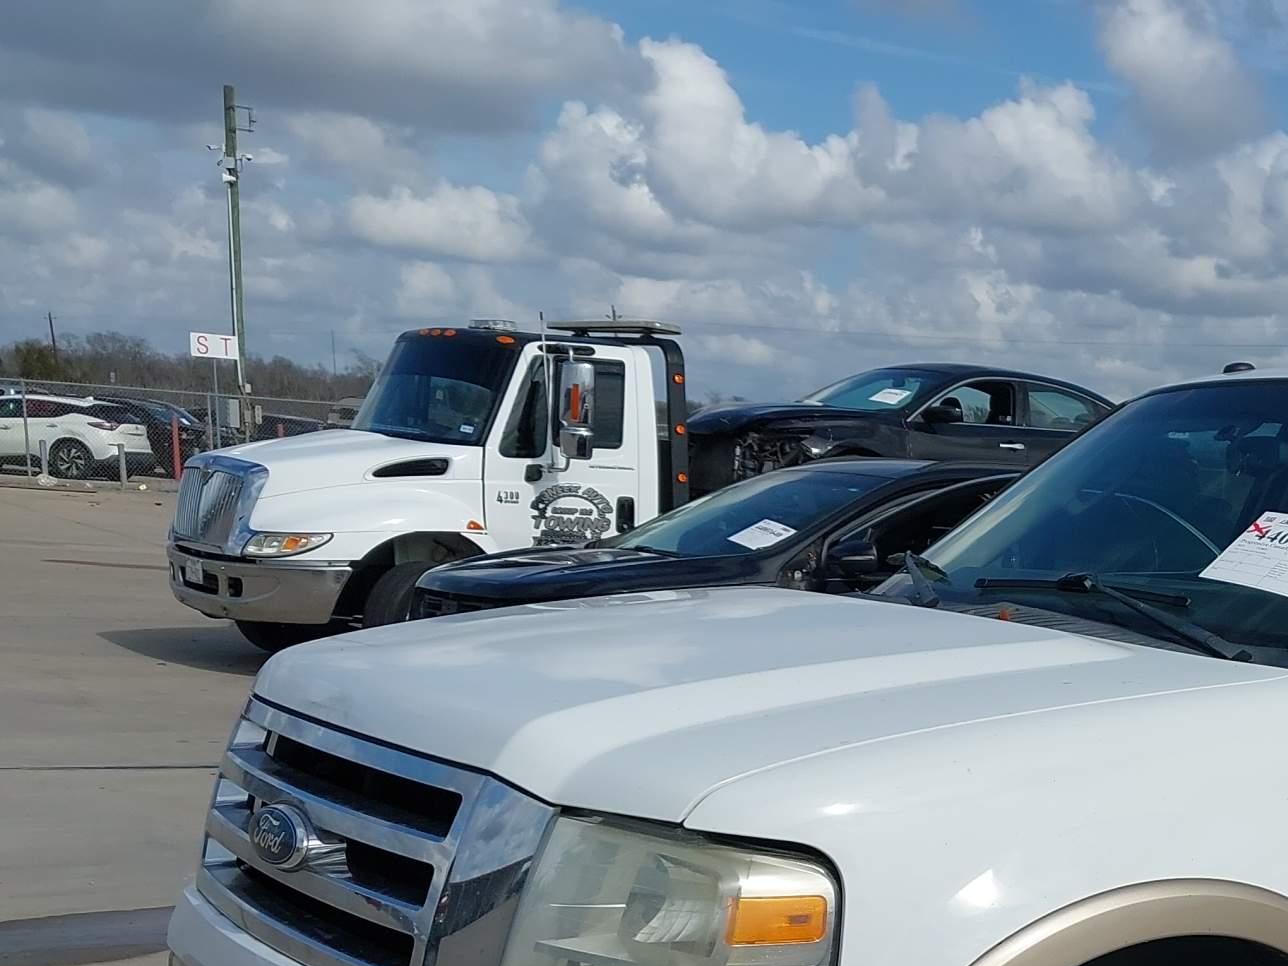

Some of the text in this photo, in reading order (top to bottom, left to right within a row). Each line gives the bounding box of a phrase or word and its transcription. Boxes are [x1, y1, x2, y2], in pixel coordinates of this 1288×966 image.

[197, 335, 232, 356] S T
[531, 515, 612, 532] TOWING
[254, 813, 285, 854] Ford
